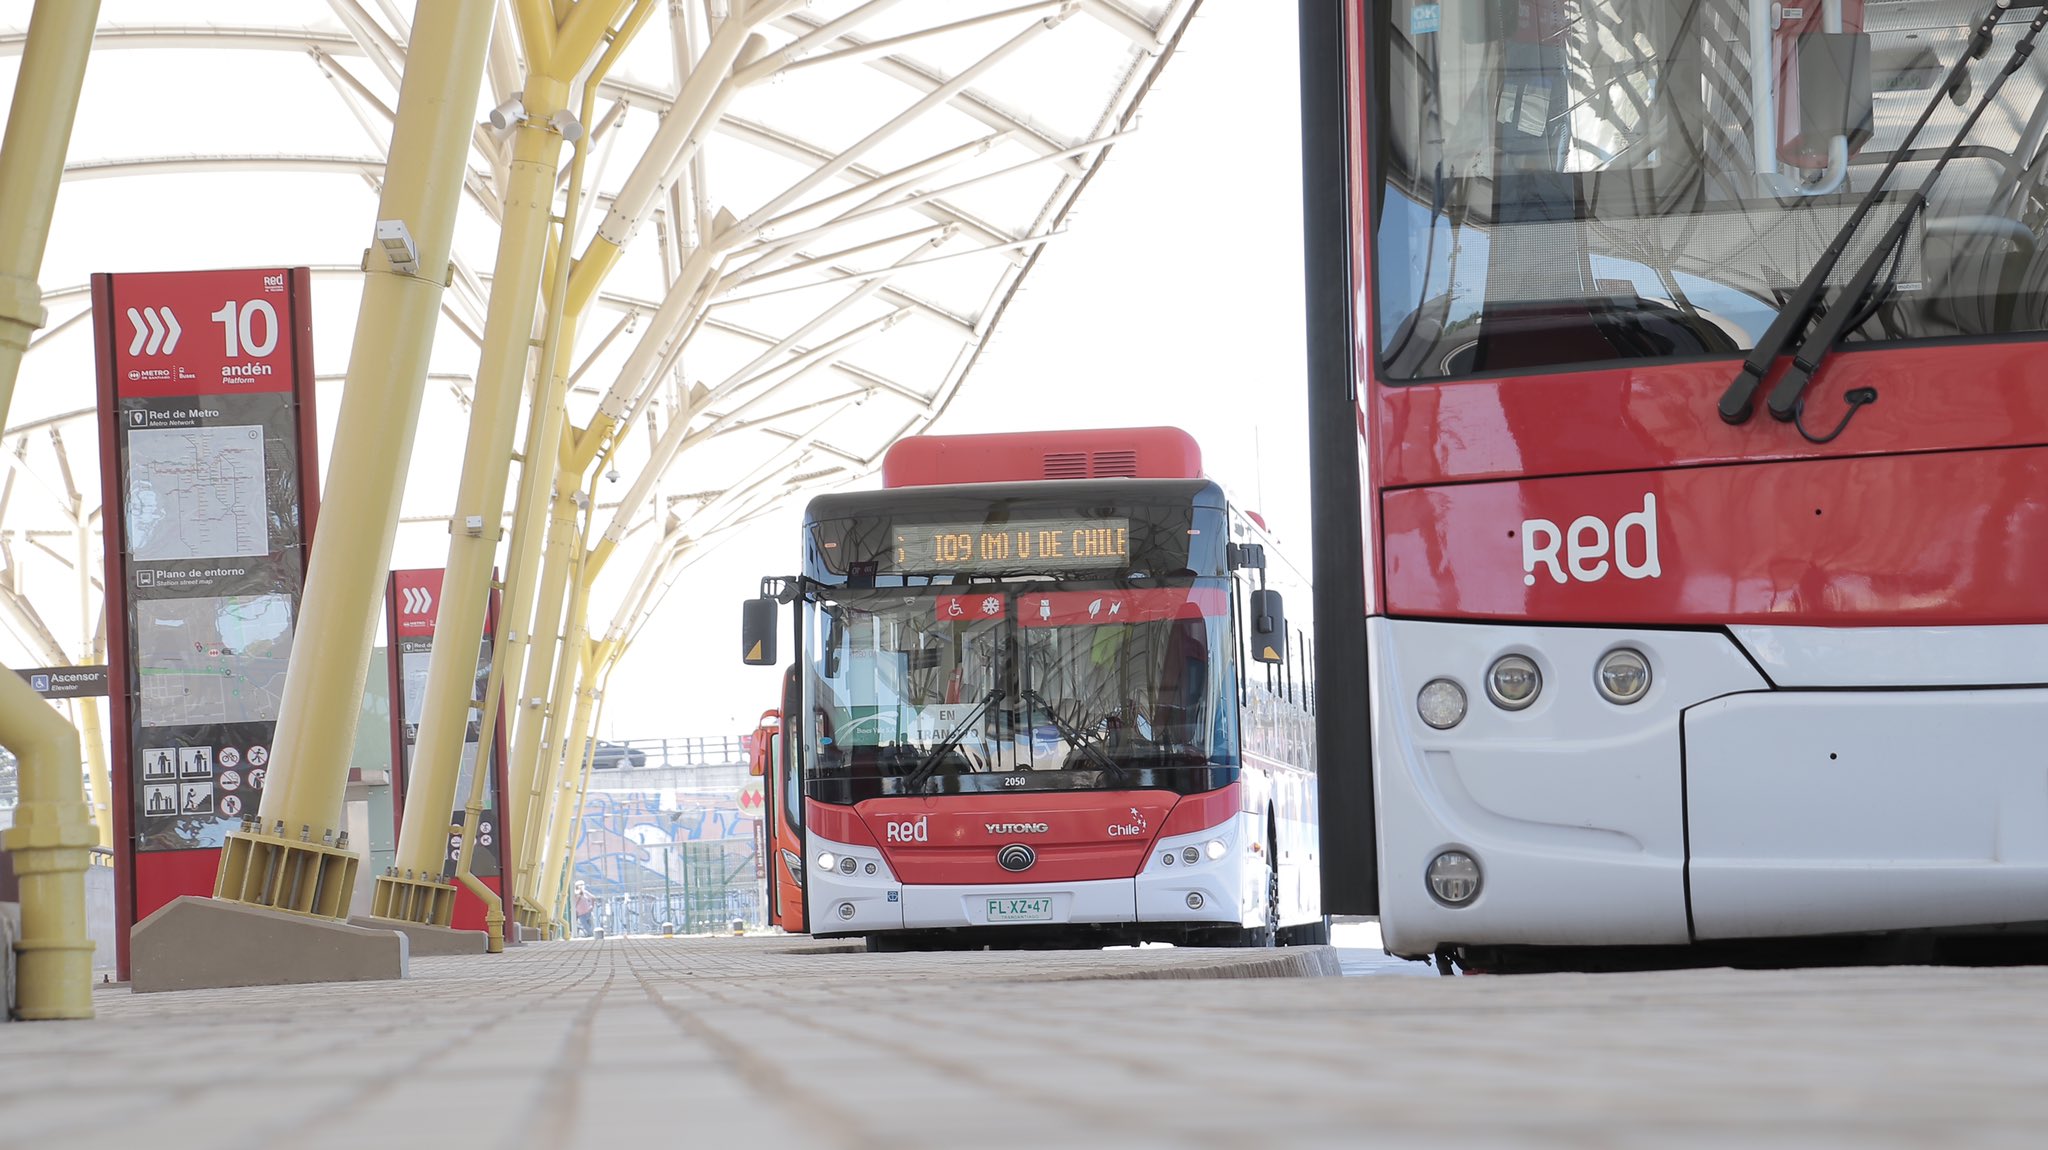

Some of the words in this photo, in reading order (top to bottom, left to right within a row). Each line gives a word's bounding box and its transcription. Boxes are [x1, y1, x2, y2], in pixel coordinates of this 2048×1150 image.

[263, 273, 284, 286] Red
[211, 299, 279, 358] 10
[141, 369, 170, 377] METRO
[221, 362, 272, 376] andén
[222, 376, 255, 384] Platform
[149, 411, 170, 419] Red
[172, 410, 186, 419] de
[188, 409, 220, 418] Metro
[980, 532, 1009, 560] (M)
[1017, 532, 1030, 558] U
[1038, 530, 1064, 557] DE
[1072, 527, 1126, 557] CHILE
[1521, 492, 1661, 586] Red
[156, 569, 186, 579] Plano
[188, 569, 202, 578] de
[204, 568, 245, 577] entorno
[51, 673, 100, 683] Ascensor
[939, 710, 955, 721] EN
[1004, 777, 1026, 787] 2050
[887, 815, 928, 842] Red
[985, 823, 1049, 834] YUTONG
[1108, 824, 1140, 836] Chile
